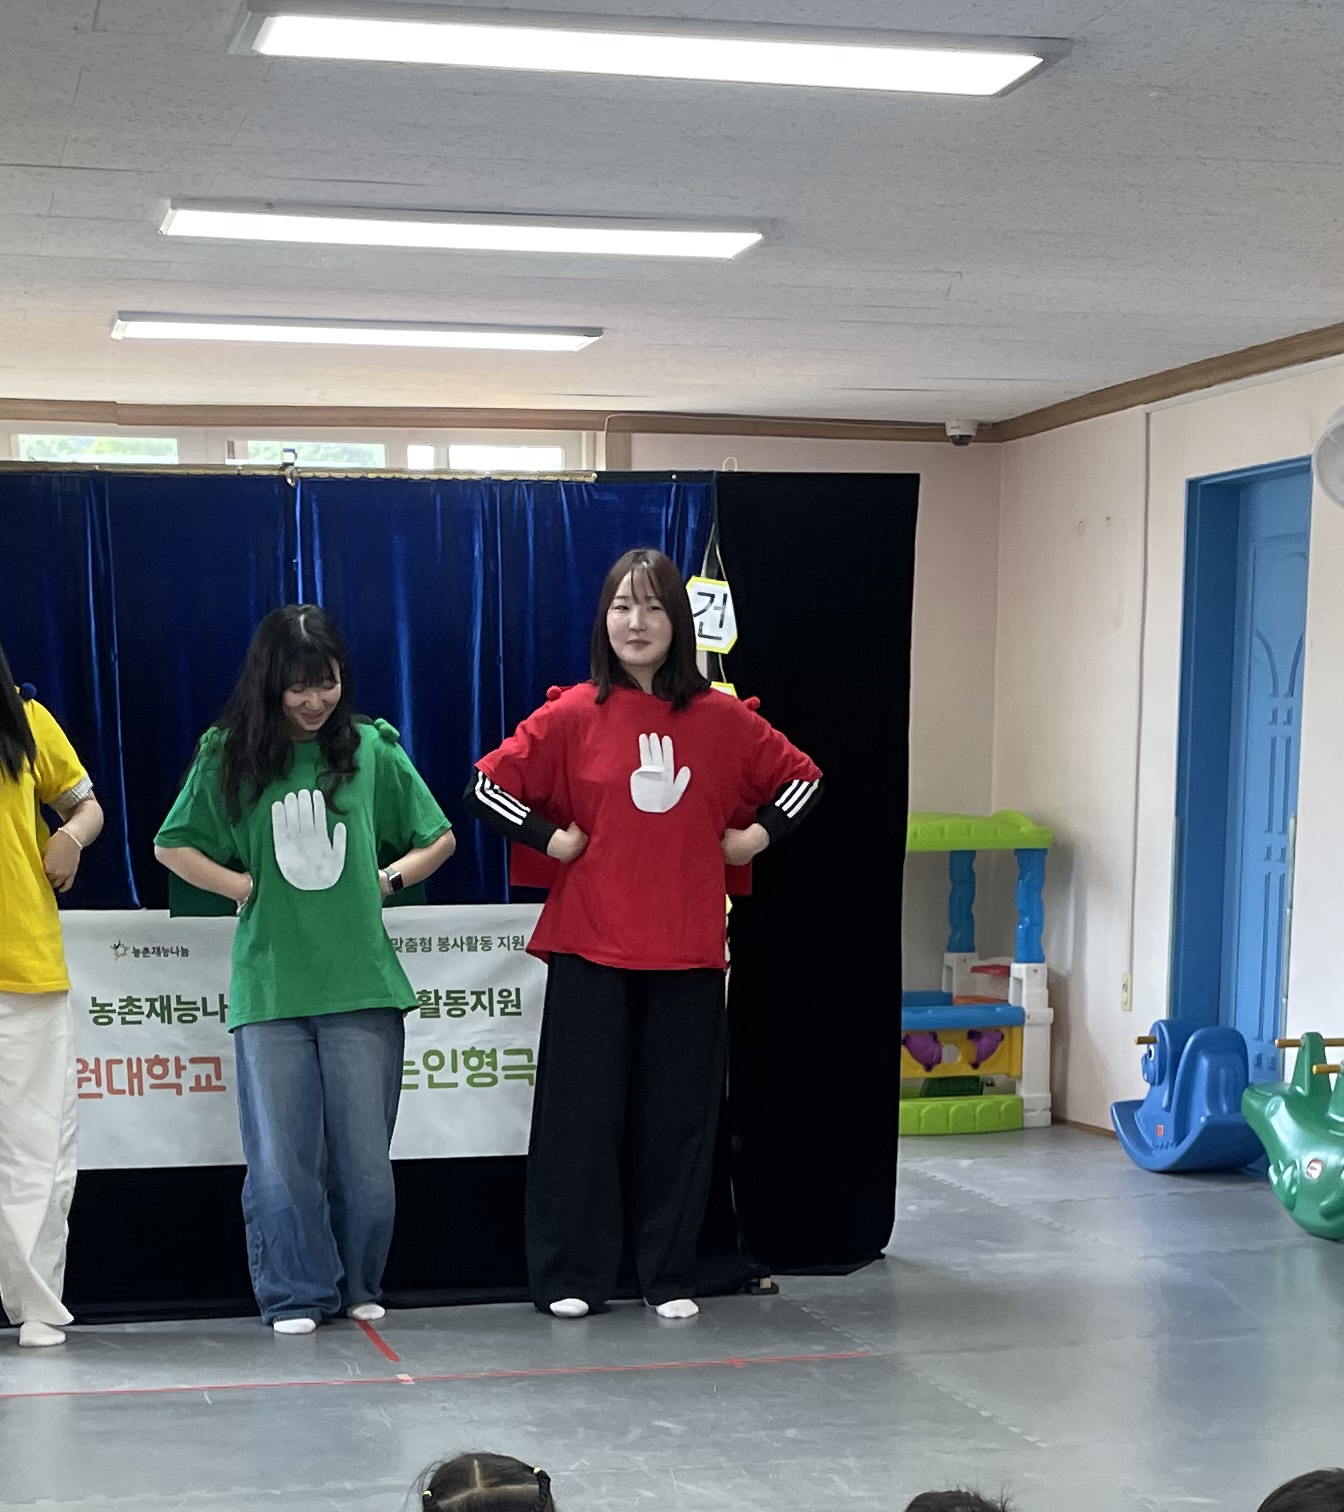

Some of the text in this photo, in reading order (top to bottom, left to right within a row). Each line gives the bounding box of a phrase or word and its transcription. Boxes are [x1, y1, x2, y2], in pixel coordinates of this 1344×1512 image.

[391, 934, 525, 953] 맞춤형 봉사활동 지원
